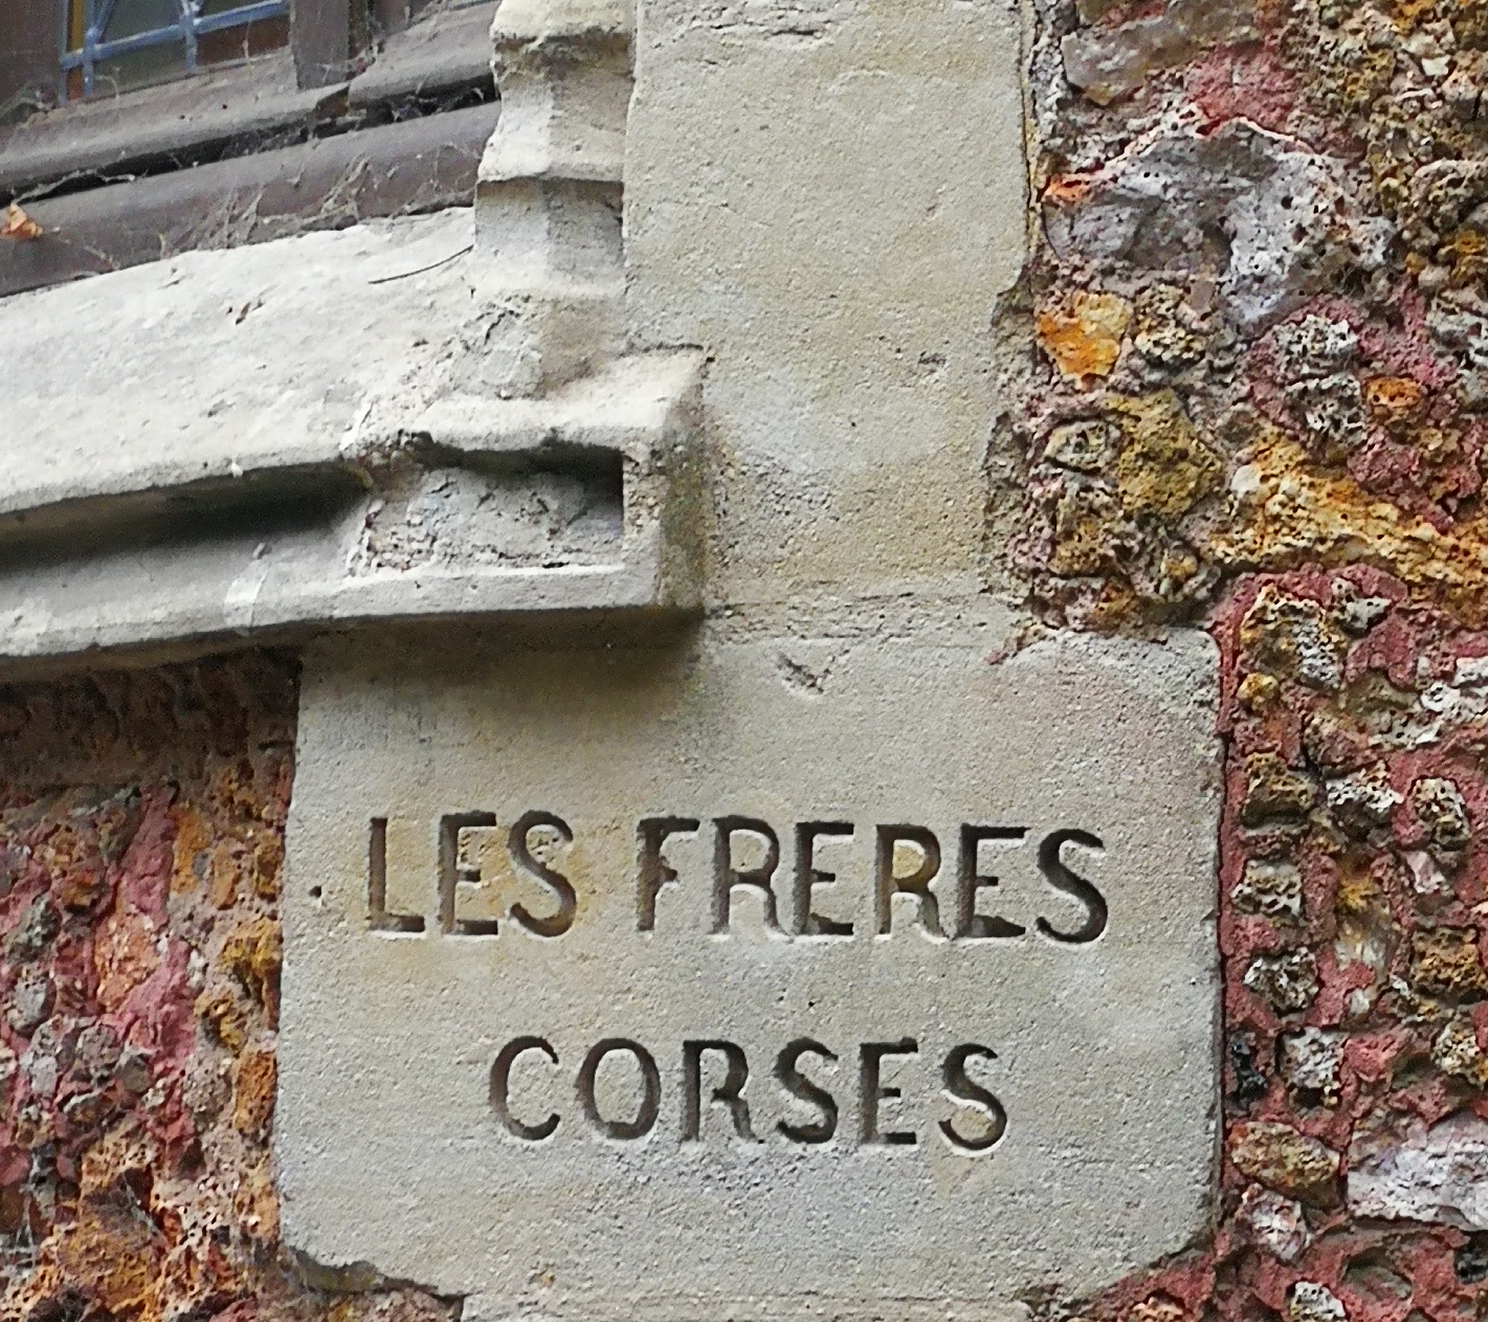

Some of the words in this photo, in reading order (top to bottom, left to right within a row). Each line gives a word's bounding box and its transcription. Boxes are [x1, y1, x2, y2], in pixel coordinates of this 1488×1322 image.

[367, 810, 578, 939] LES
[637, 814, 1109, 944] FRERES
[488, 1035, 1008, 1153] CORSES
